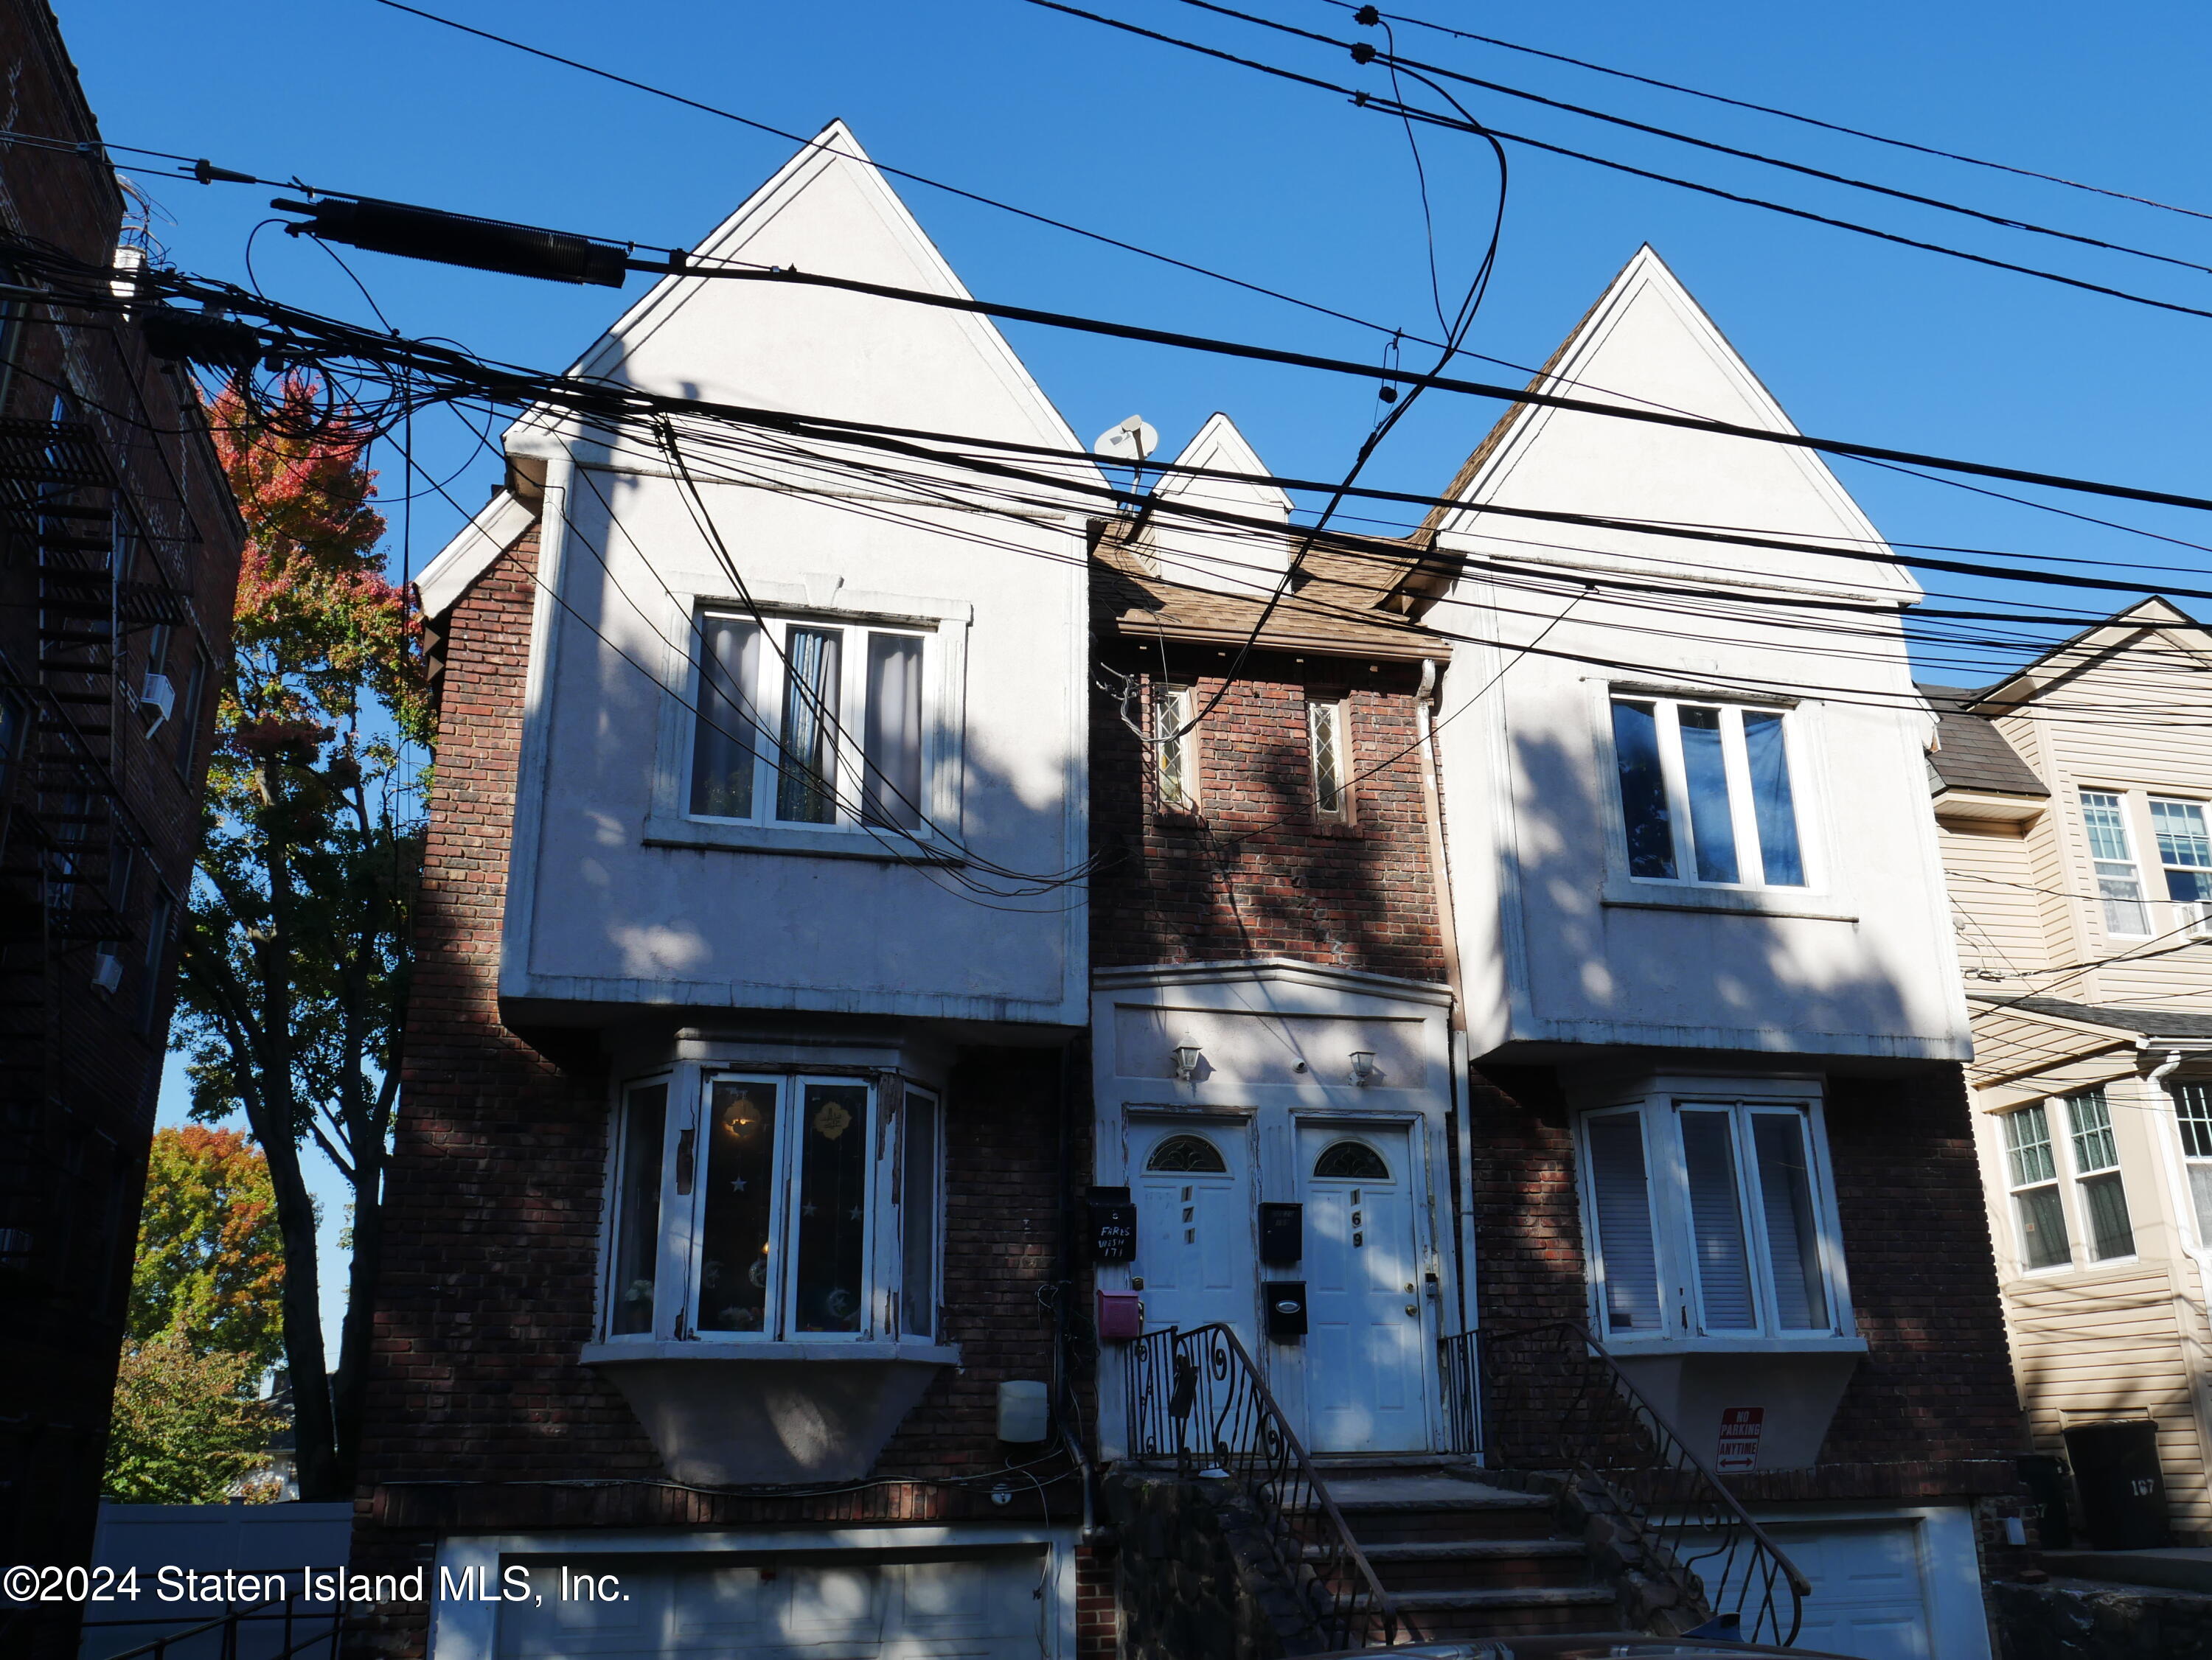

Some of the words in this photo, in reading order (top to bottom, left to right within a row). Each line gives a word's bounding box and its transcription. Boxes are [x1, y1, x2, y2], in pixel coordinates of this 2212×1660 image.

[1105, 1248, 1123, 1257] 171
[1736, 1410, 1750, 1422] NO
[1721, 1423, 1761, 1436] PARKING
[1719, 1443, 1757, 1455] ANYTIME
[2131, 1479, 2154, 1496] 167
